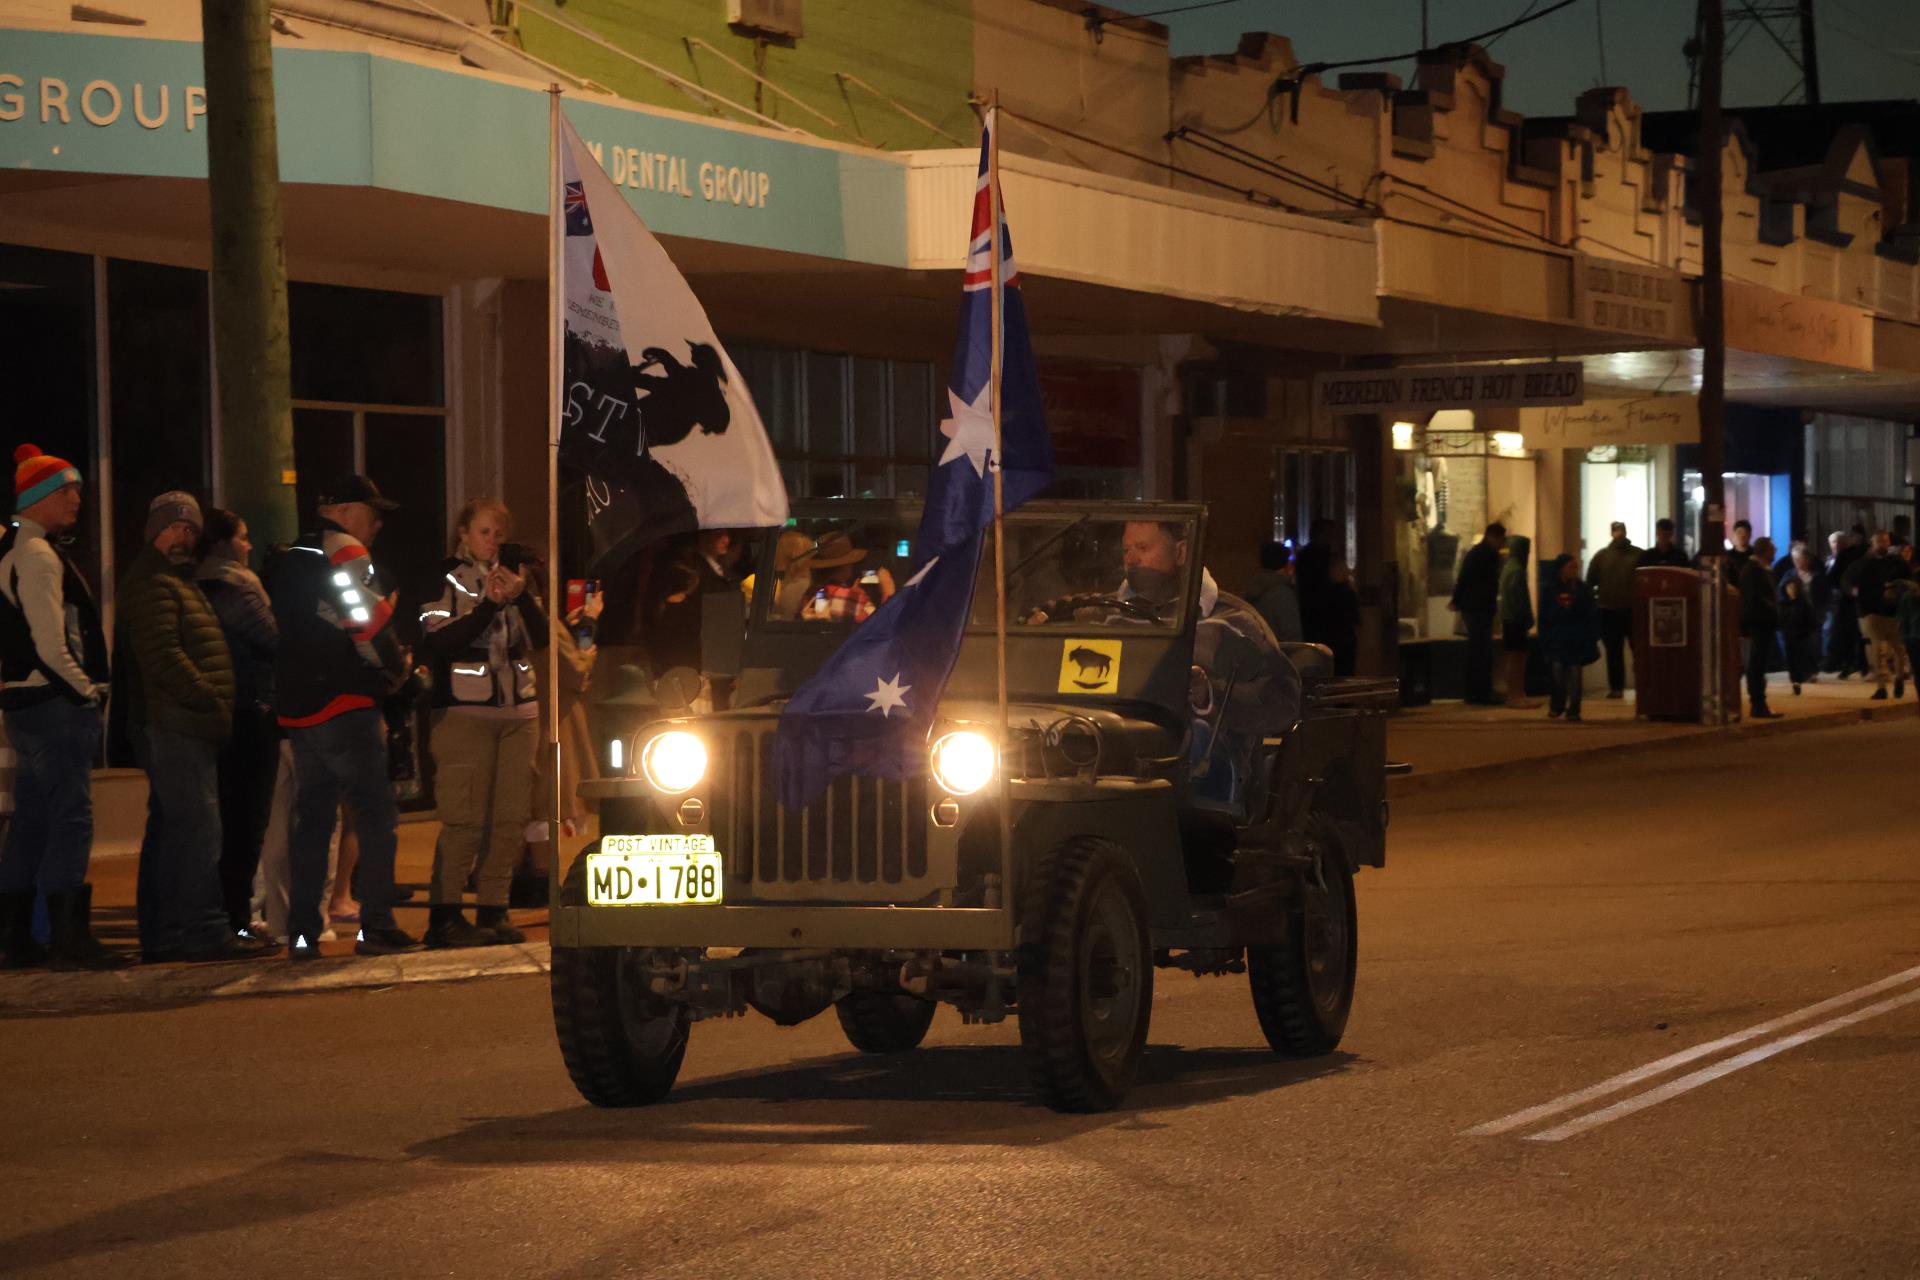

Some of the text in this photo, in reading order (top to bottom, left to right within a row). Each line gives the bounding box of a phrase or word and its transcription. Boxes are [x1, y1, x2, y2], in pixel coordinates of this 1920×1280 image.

[0, 73, 208, 131] GROUP
[611, 145, 693, 198] DENTAL
[699, 161, 770, 209] GROUP
[1321, 372, 1578, 406] MERREDIN FRENCH HOT BREAD
[607, 838, 707, 853] POST VINTAGE
